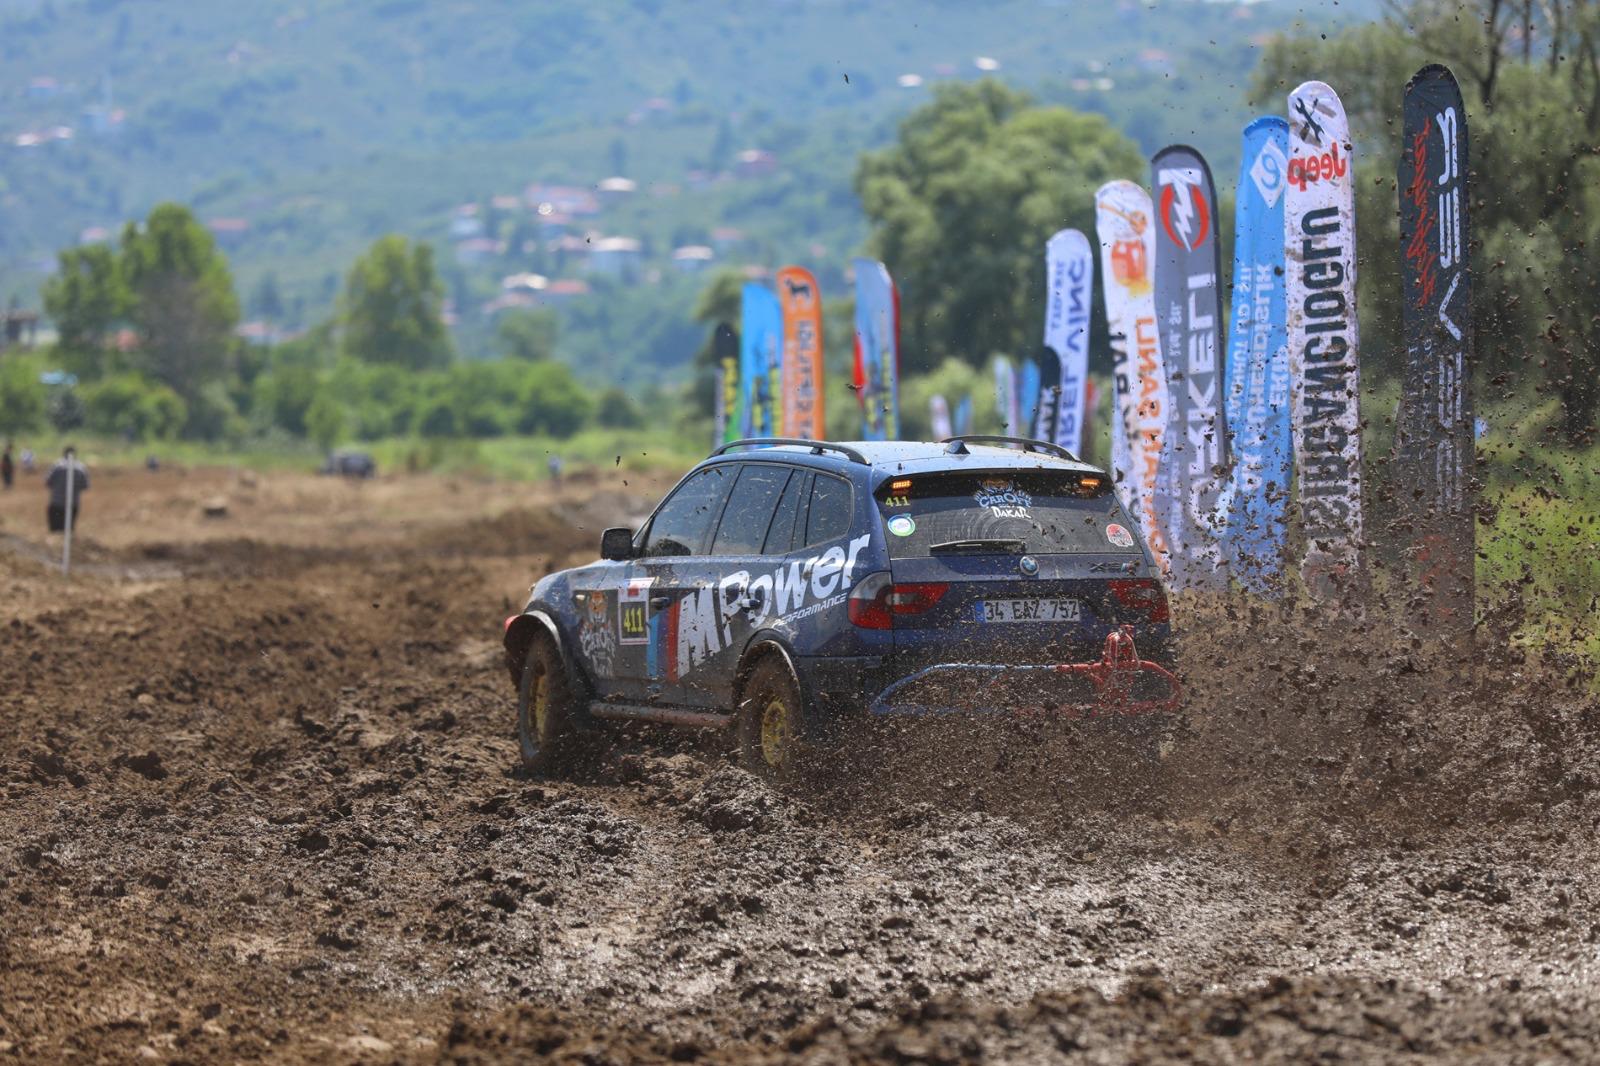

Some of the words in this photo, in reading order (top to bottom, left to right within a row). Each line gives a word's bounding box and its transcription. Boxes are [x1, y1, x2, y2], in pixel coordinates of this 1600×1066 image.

[885, 495, 911, 507] 411
[991, 505, 1032, 519] DAKAR
[984, 601, 1004, 621] 34
[623, 607, 644, 633] 411
